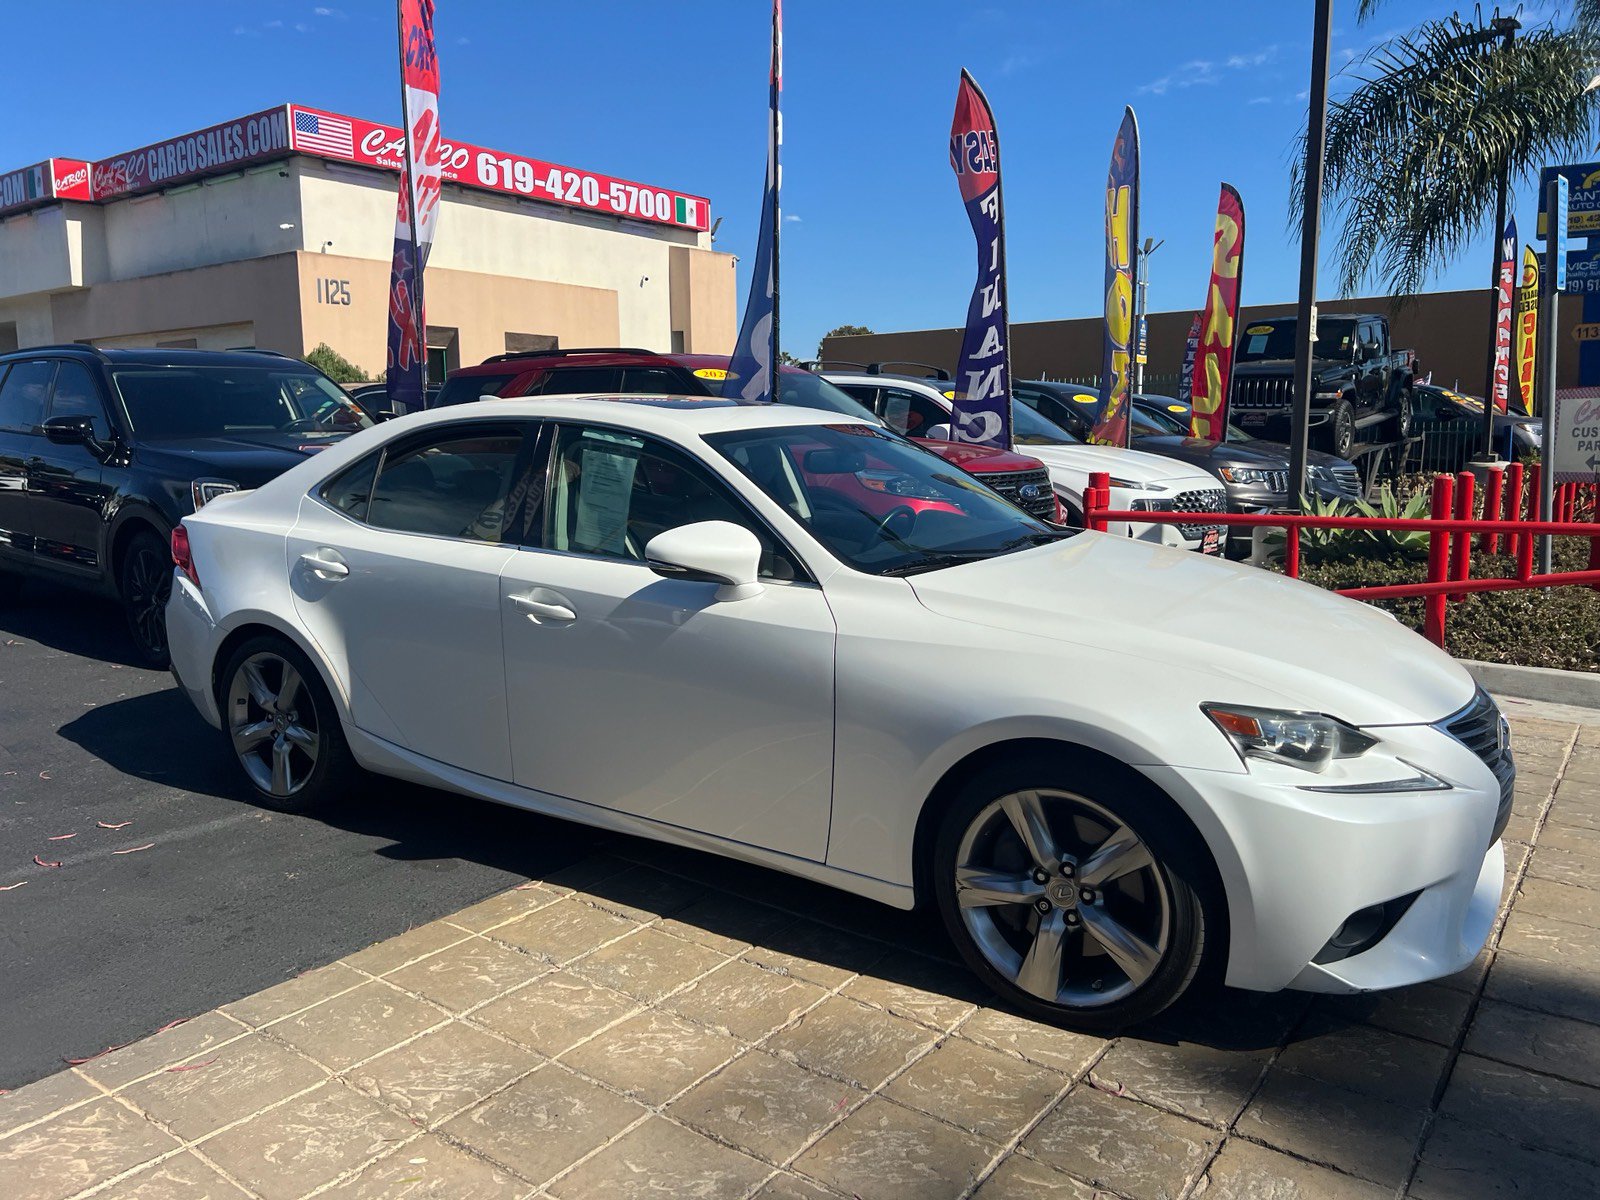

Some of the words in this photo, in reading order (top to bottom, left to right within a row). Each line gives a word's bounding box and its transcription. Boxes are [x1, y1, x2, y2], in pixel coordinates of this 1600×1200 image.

[92, 153, 145, 192] CARCO
[147, 111, 287, 182] CARCOSALES.COM
[376, 157, 402, 168] Sales
[55, 168, 87, 190] CARCO
[360, 129, 469, 169] CACO
[477, 152, 671, 221] 619-420-5700
[317, 278, 351, 305] 1125
